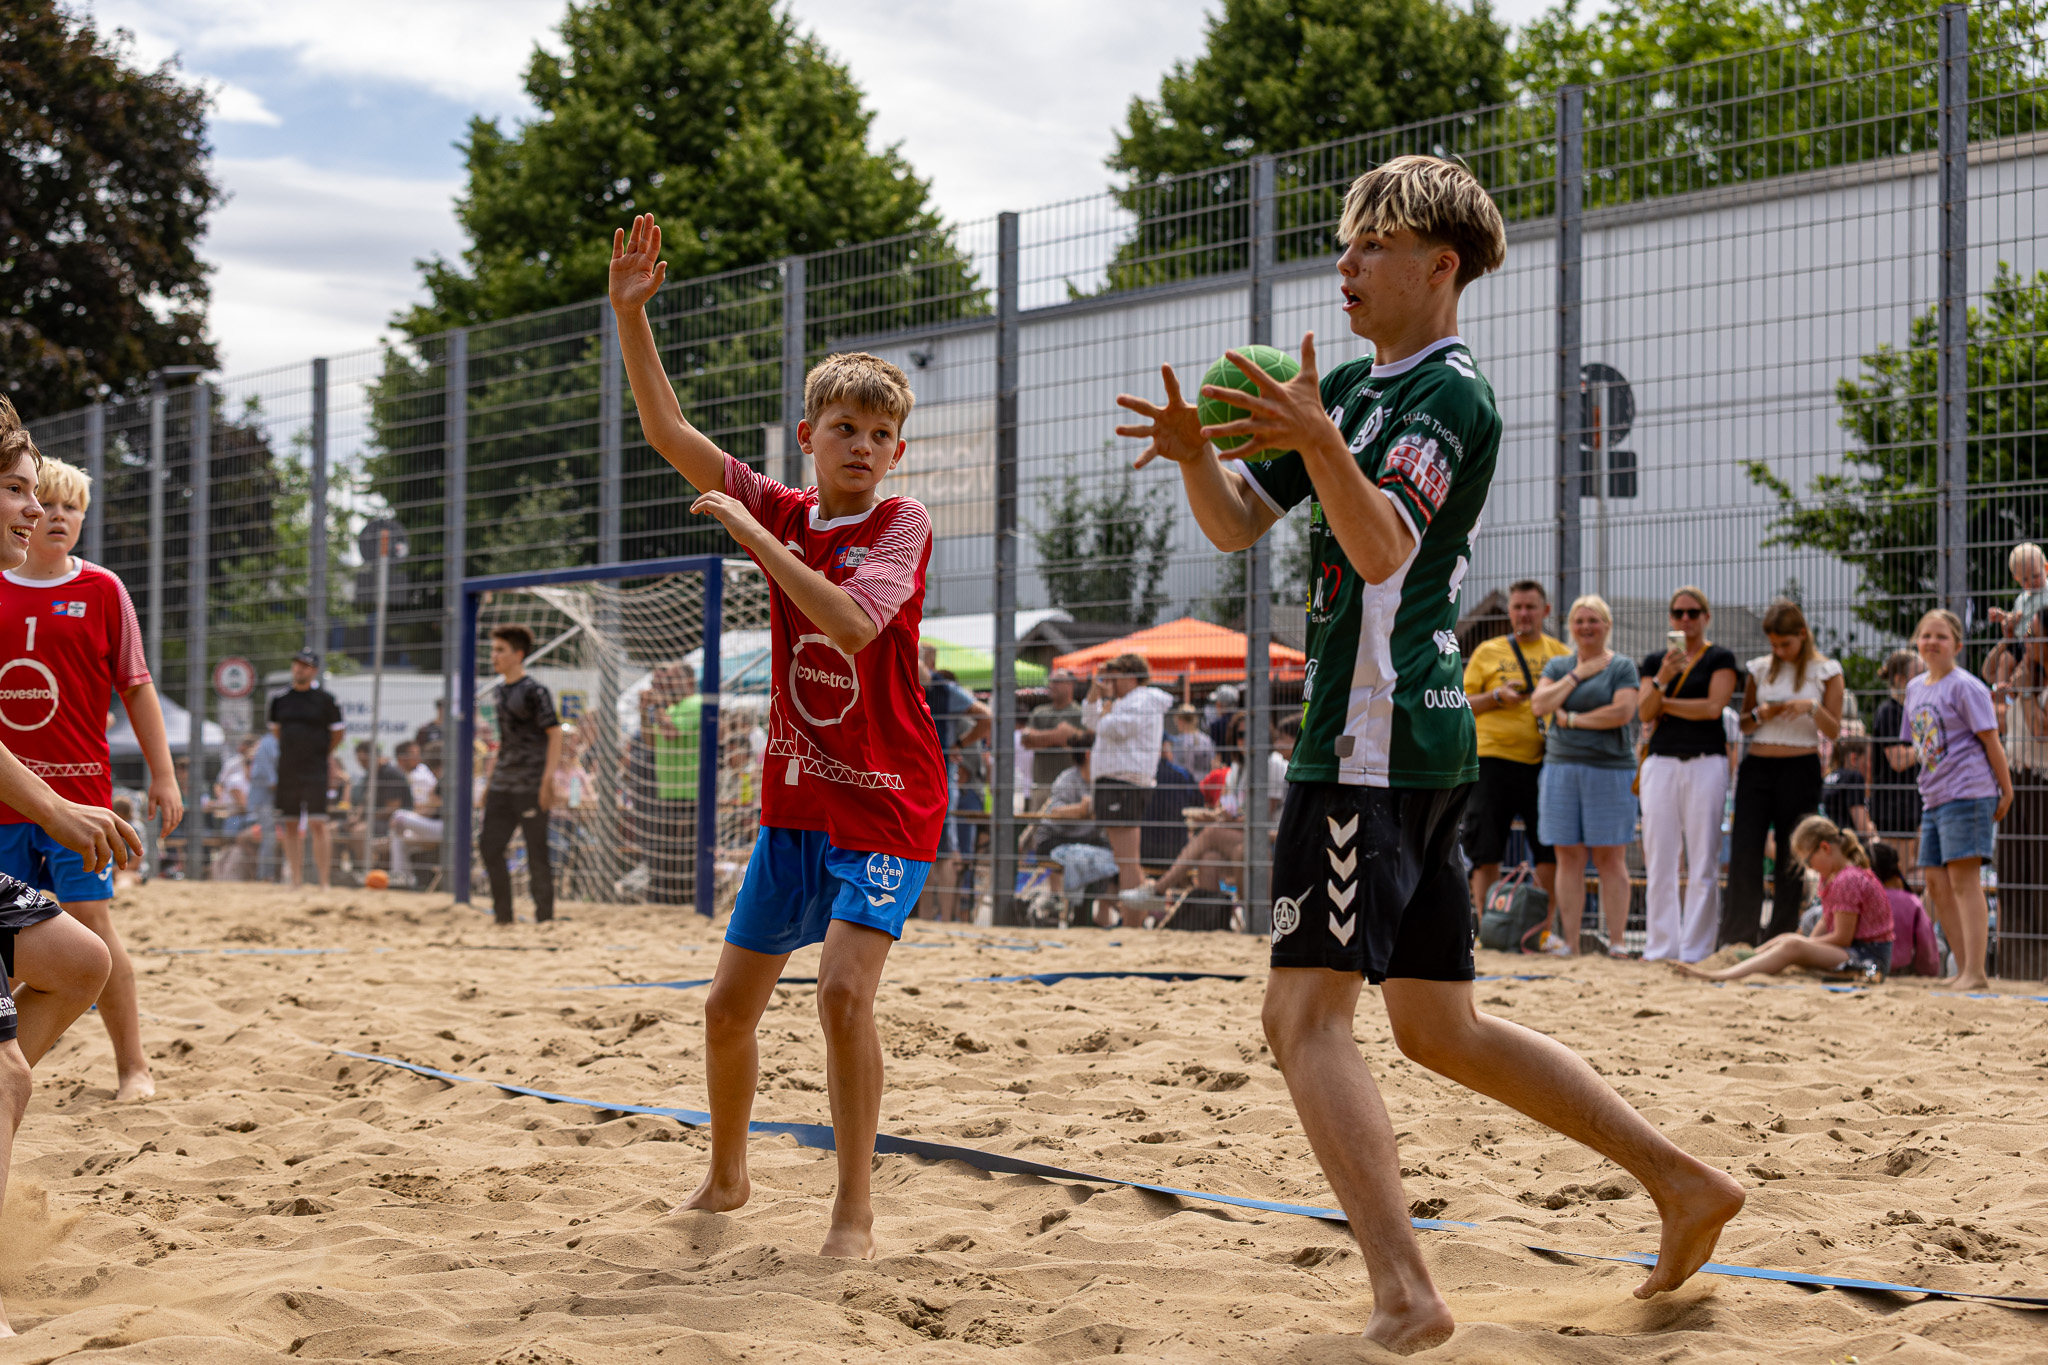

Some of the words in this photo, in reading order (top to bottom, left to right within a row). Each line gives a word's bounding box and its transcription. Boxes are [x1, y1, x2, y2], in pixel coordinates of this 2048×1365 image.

[1403, 412, 1432, 426] HAUS
[25, 616, 38, 651] 1
[870, 865, 902, 878] BAYER
[882, 854, 890, 887] BAYER
